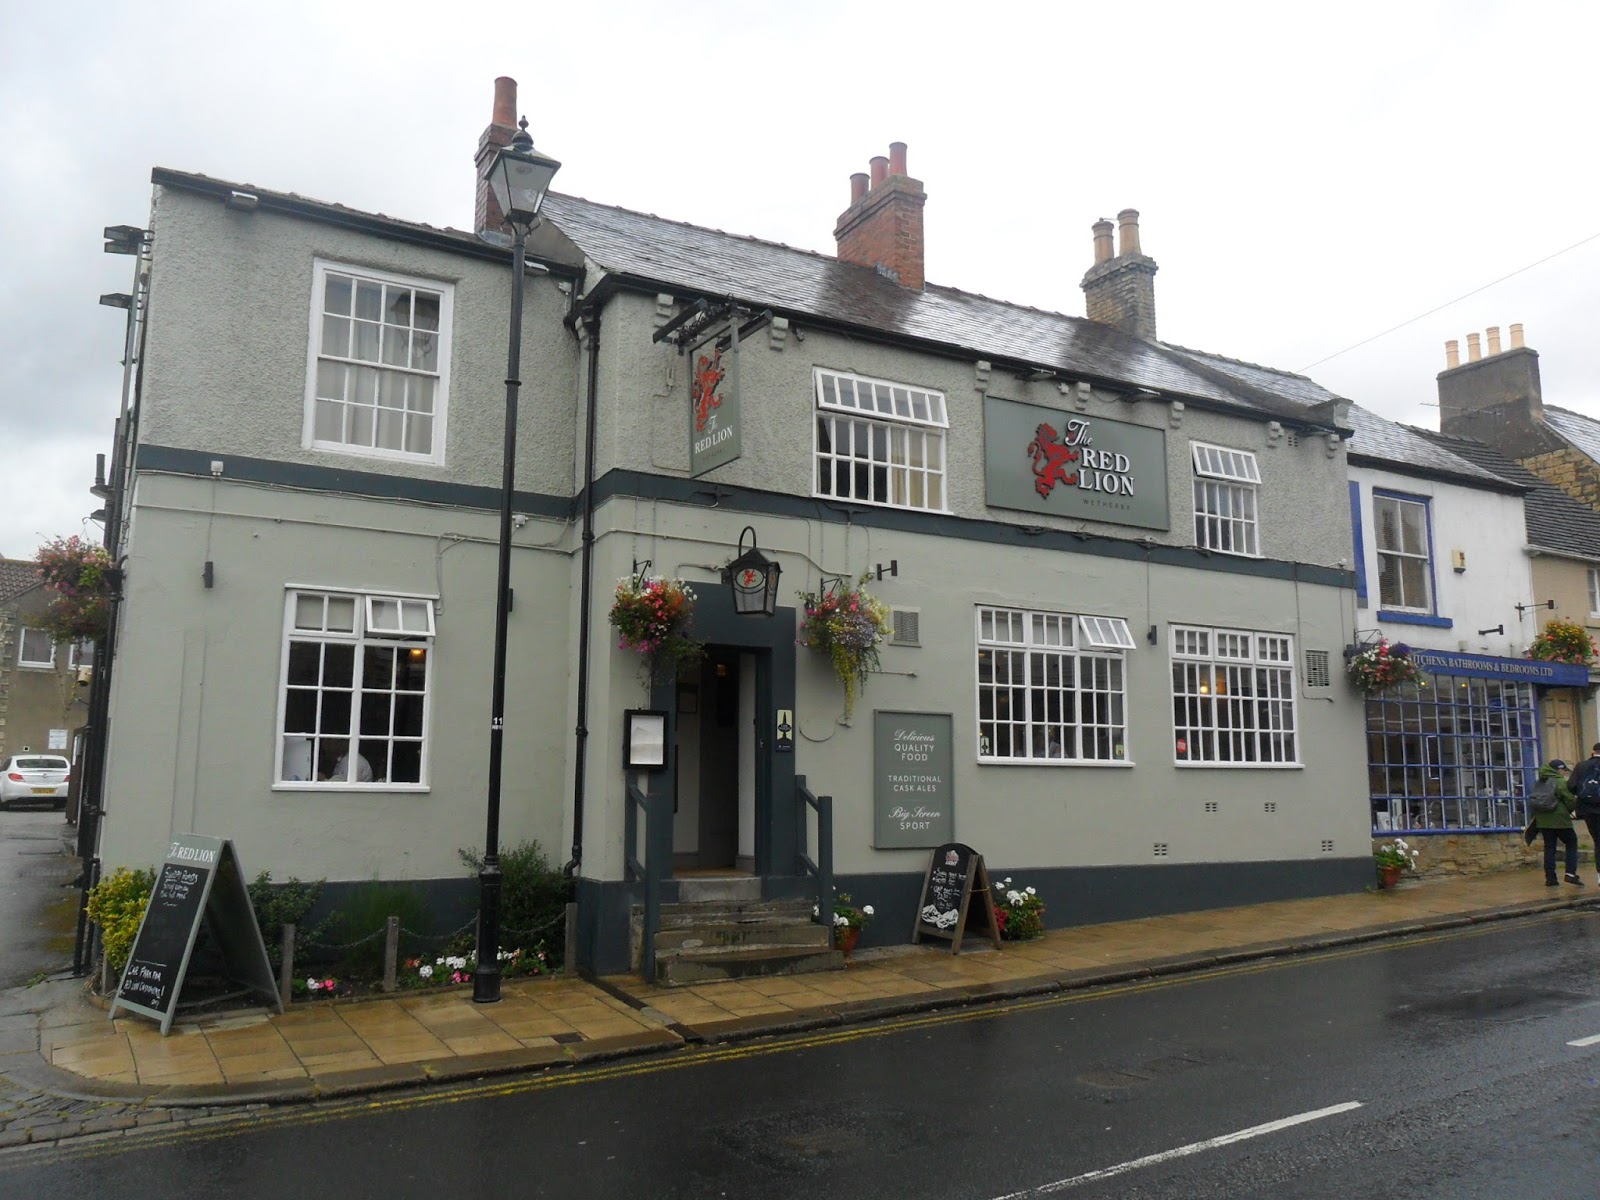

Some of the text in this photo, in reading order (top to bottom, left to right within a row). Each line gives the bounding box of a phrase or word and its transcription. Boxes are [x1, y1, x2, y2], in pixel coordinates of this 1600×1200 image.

[695, 425, 732, 454] RED LION
[1065, 419, 1093, 446] The
[1081, 447, 1130, 473] RED
[1078, 469, 1135, 496] LION
[1411, 655, 1553, 676] ITCHENS, BATHROOMS & BEDROOMS LTD
[894, 729, 935, 742] Delicious
[894, 744, 935, 752] QUALITY
[902, 753, 928, 761] FOOD
[888, 806, 910, 821] Big
[900, 822, 930, 830] SPORT
[177, 847, 194, 859] RED
[194, 849, 215, 862] LION
